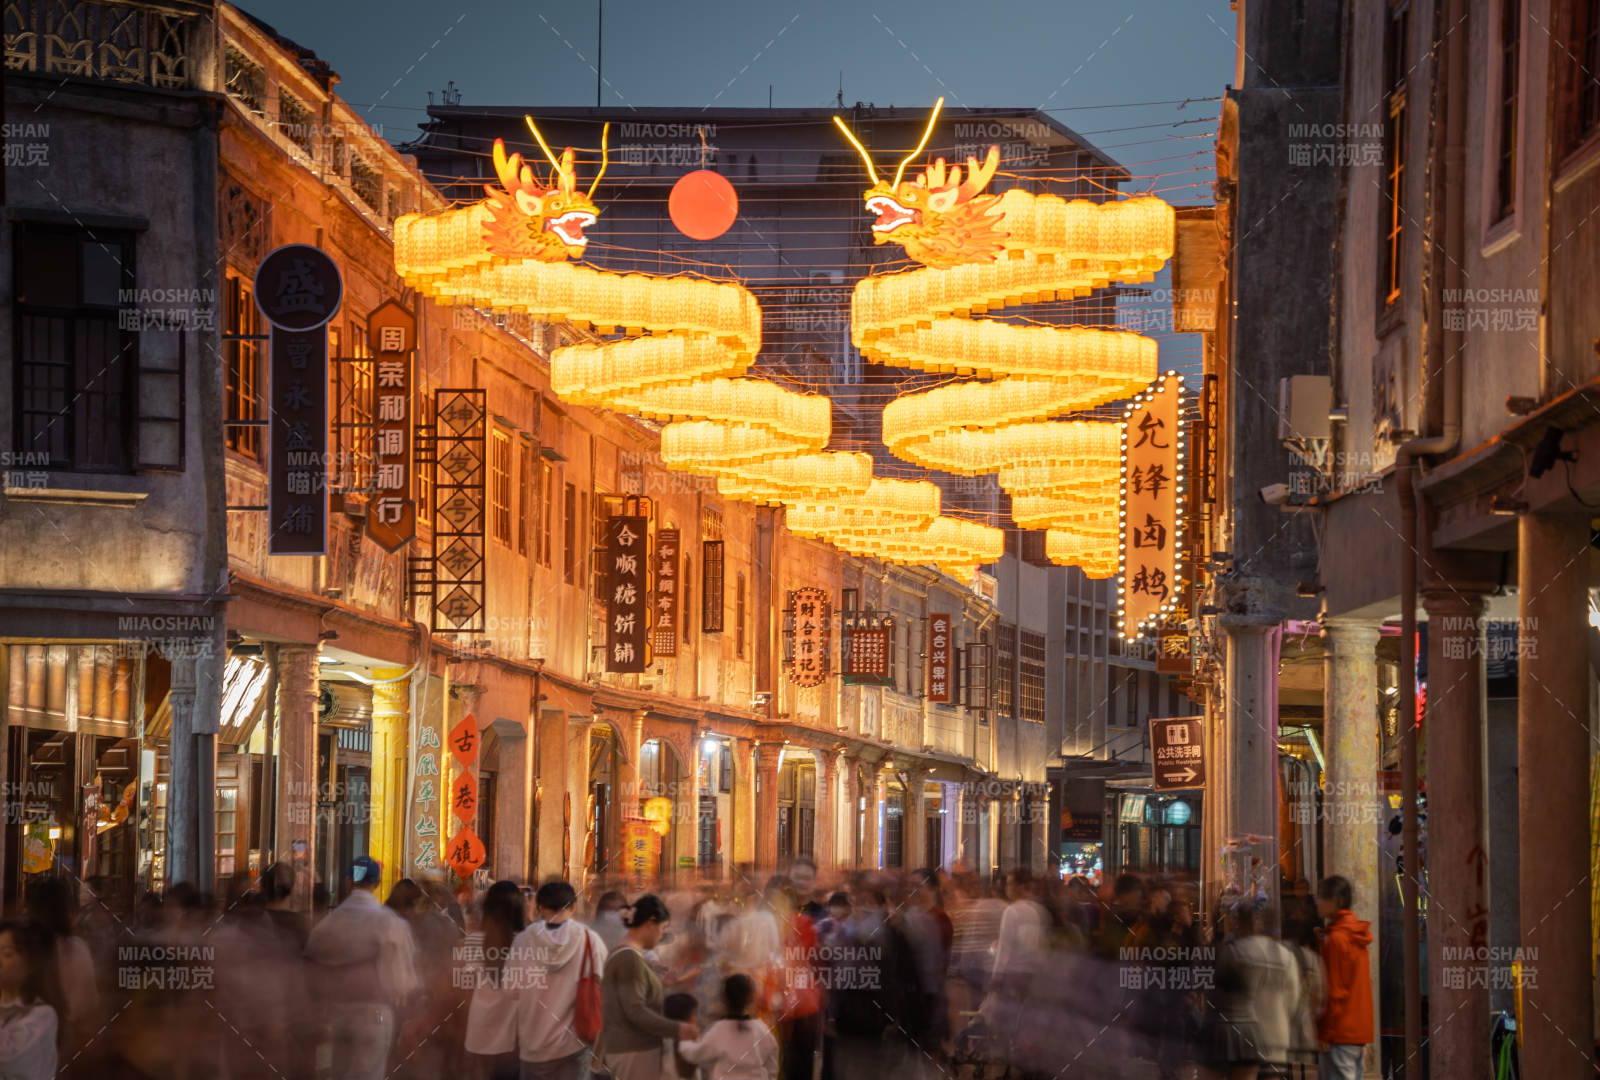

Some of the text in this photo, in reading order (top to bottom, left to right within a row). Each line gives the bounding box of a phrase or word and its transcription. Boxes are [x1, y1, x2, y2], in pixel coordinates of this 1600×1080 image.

[445, 403, 475, 618] 坤发号茶庄
[1157, 745, 1201, 759] 公共洗手间
